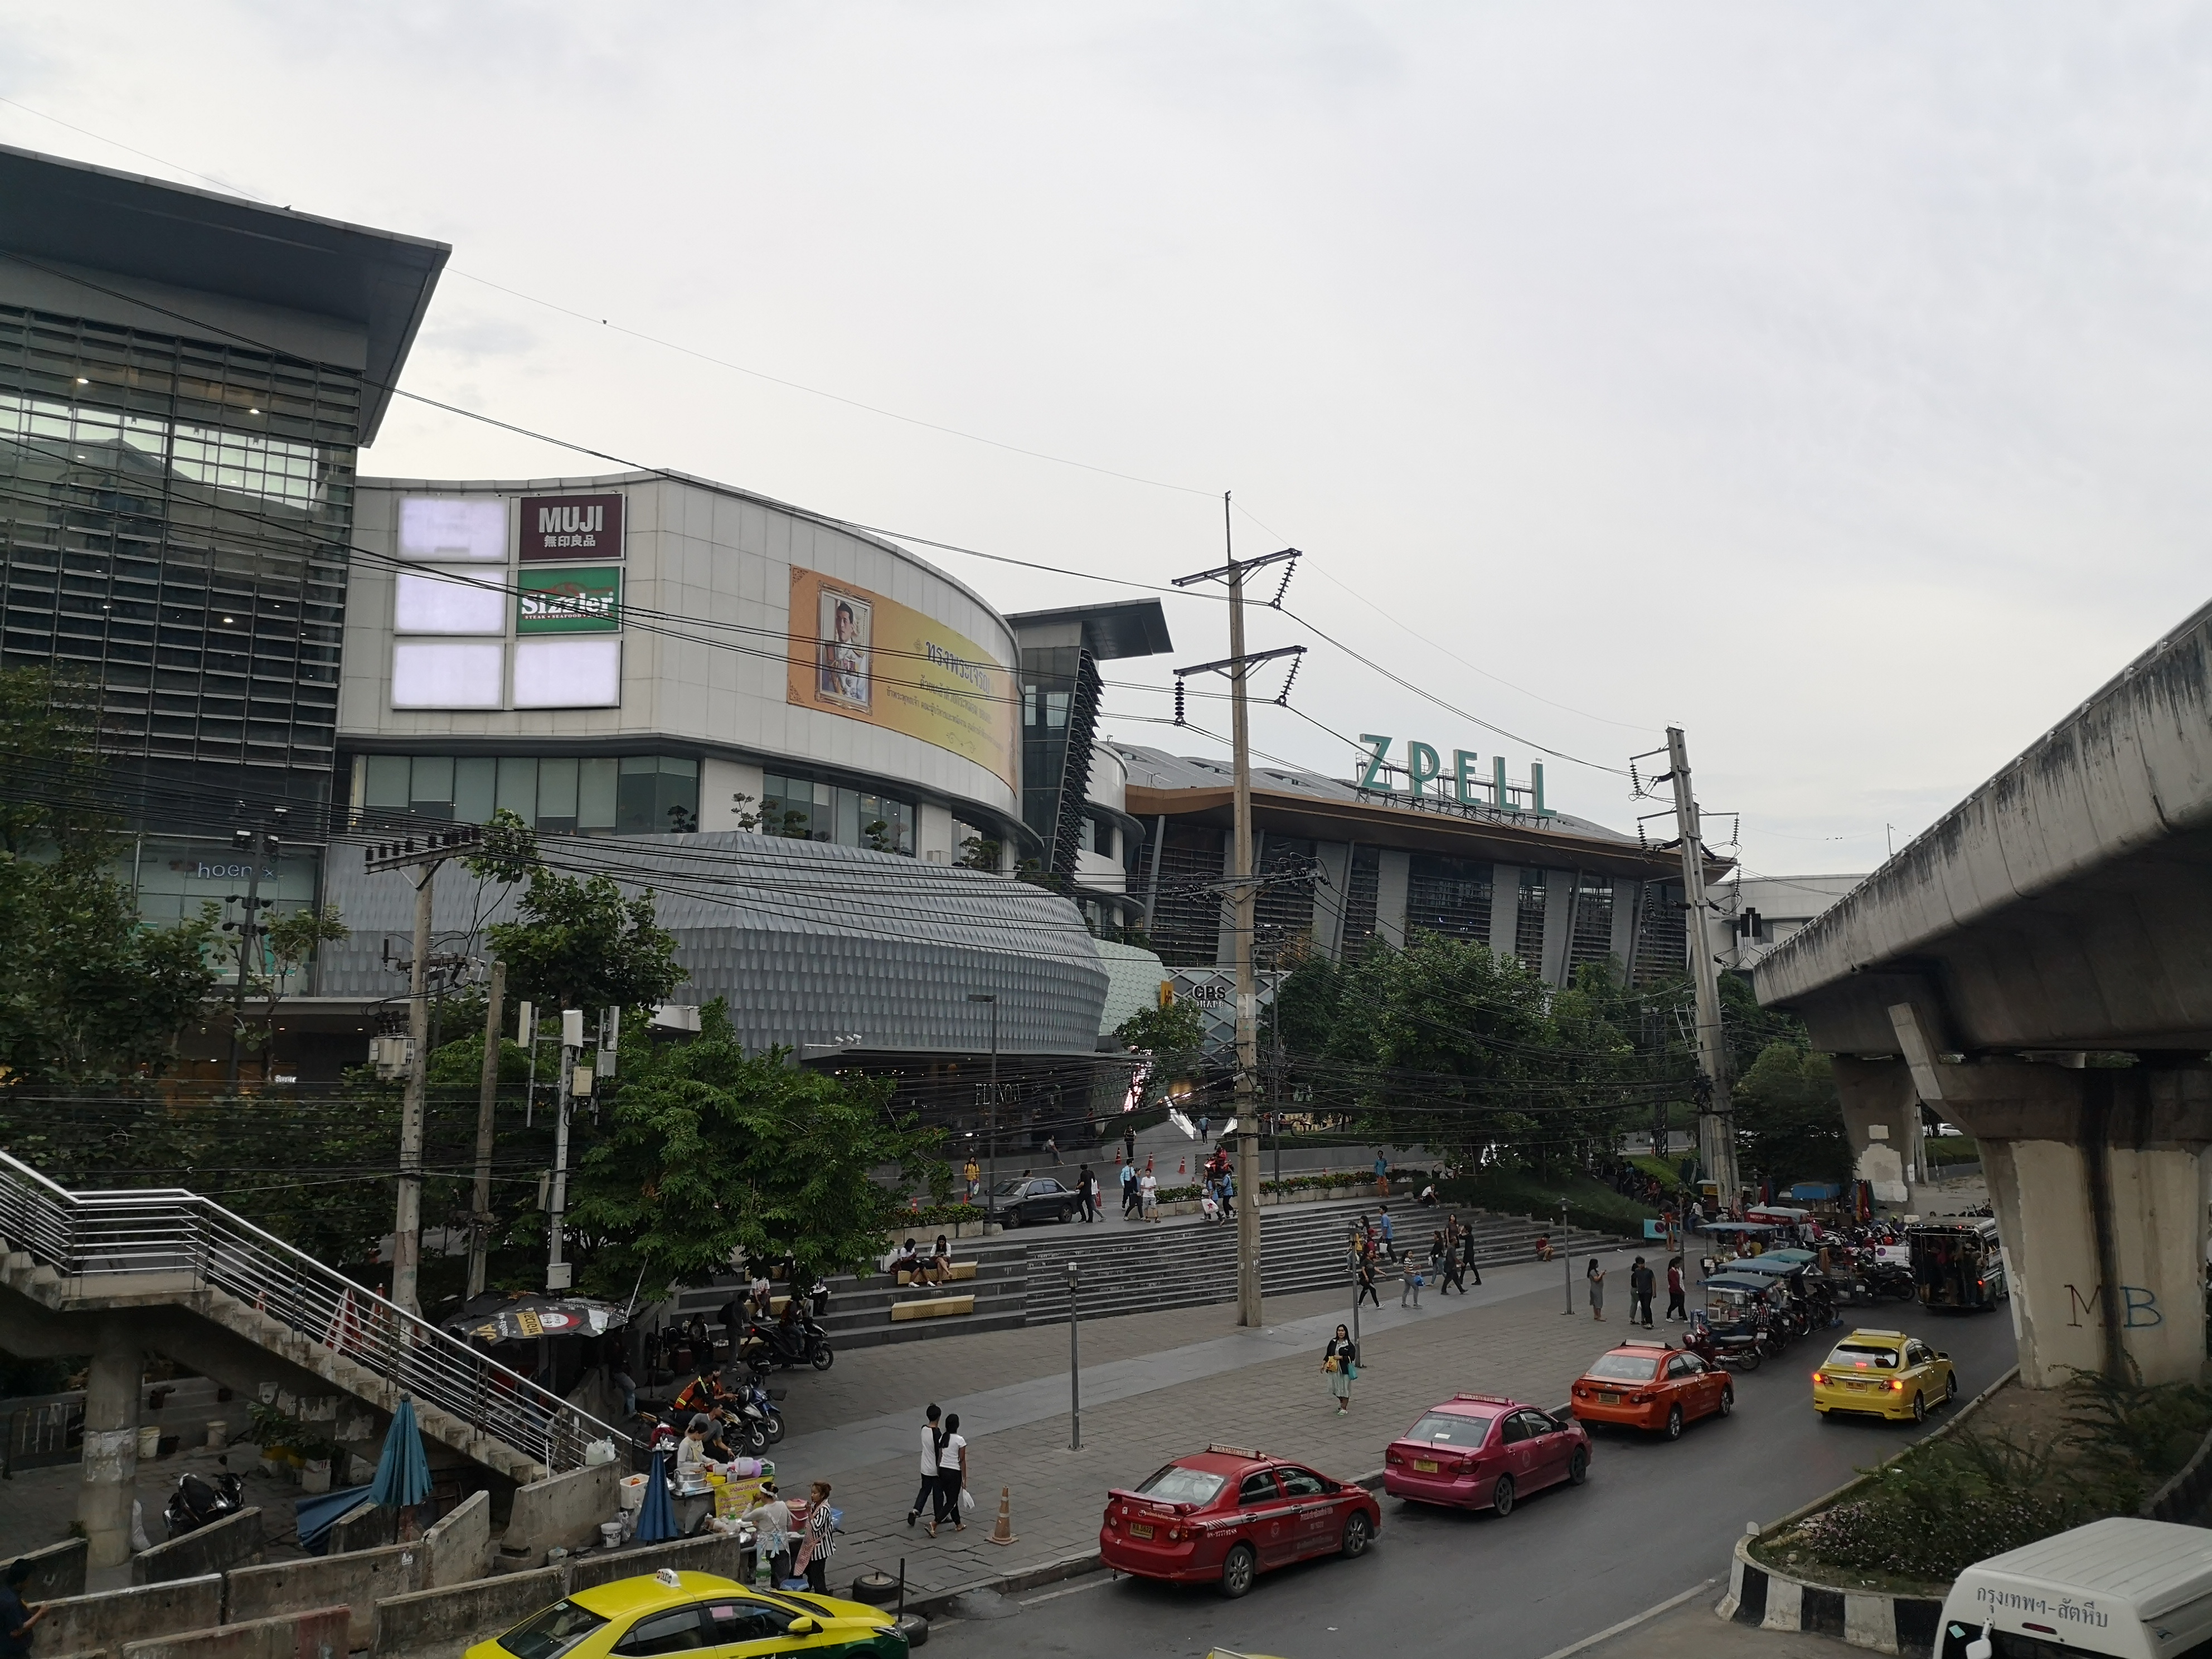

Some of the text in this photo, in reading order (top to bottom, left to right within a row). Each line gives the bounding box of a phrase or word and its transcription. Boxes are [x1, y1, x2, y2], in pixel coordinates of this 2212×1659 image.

[539, 506, 603, 533] MUJI
[544, 534, 596, 548] 無印良品
[522, 593, 614, 614] Sizzler
[1356, 733, 1557, 817] ZPELL
[1192, 984, 1226, 1000] CPS
